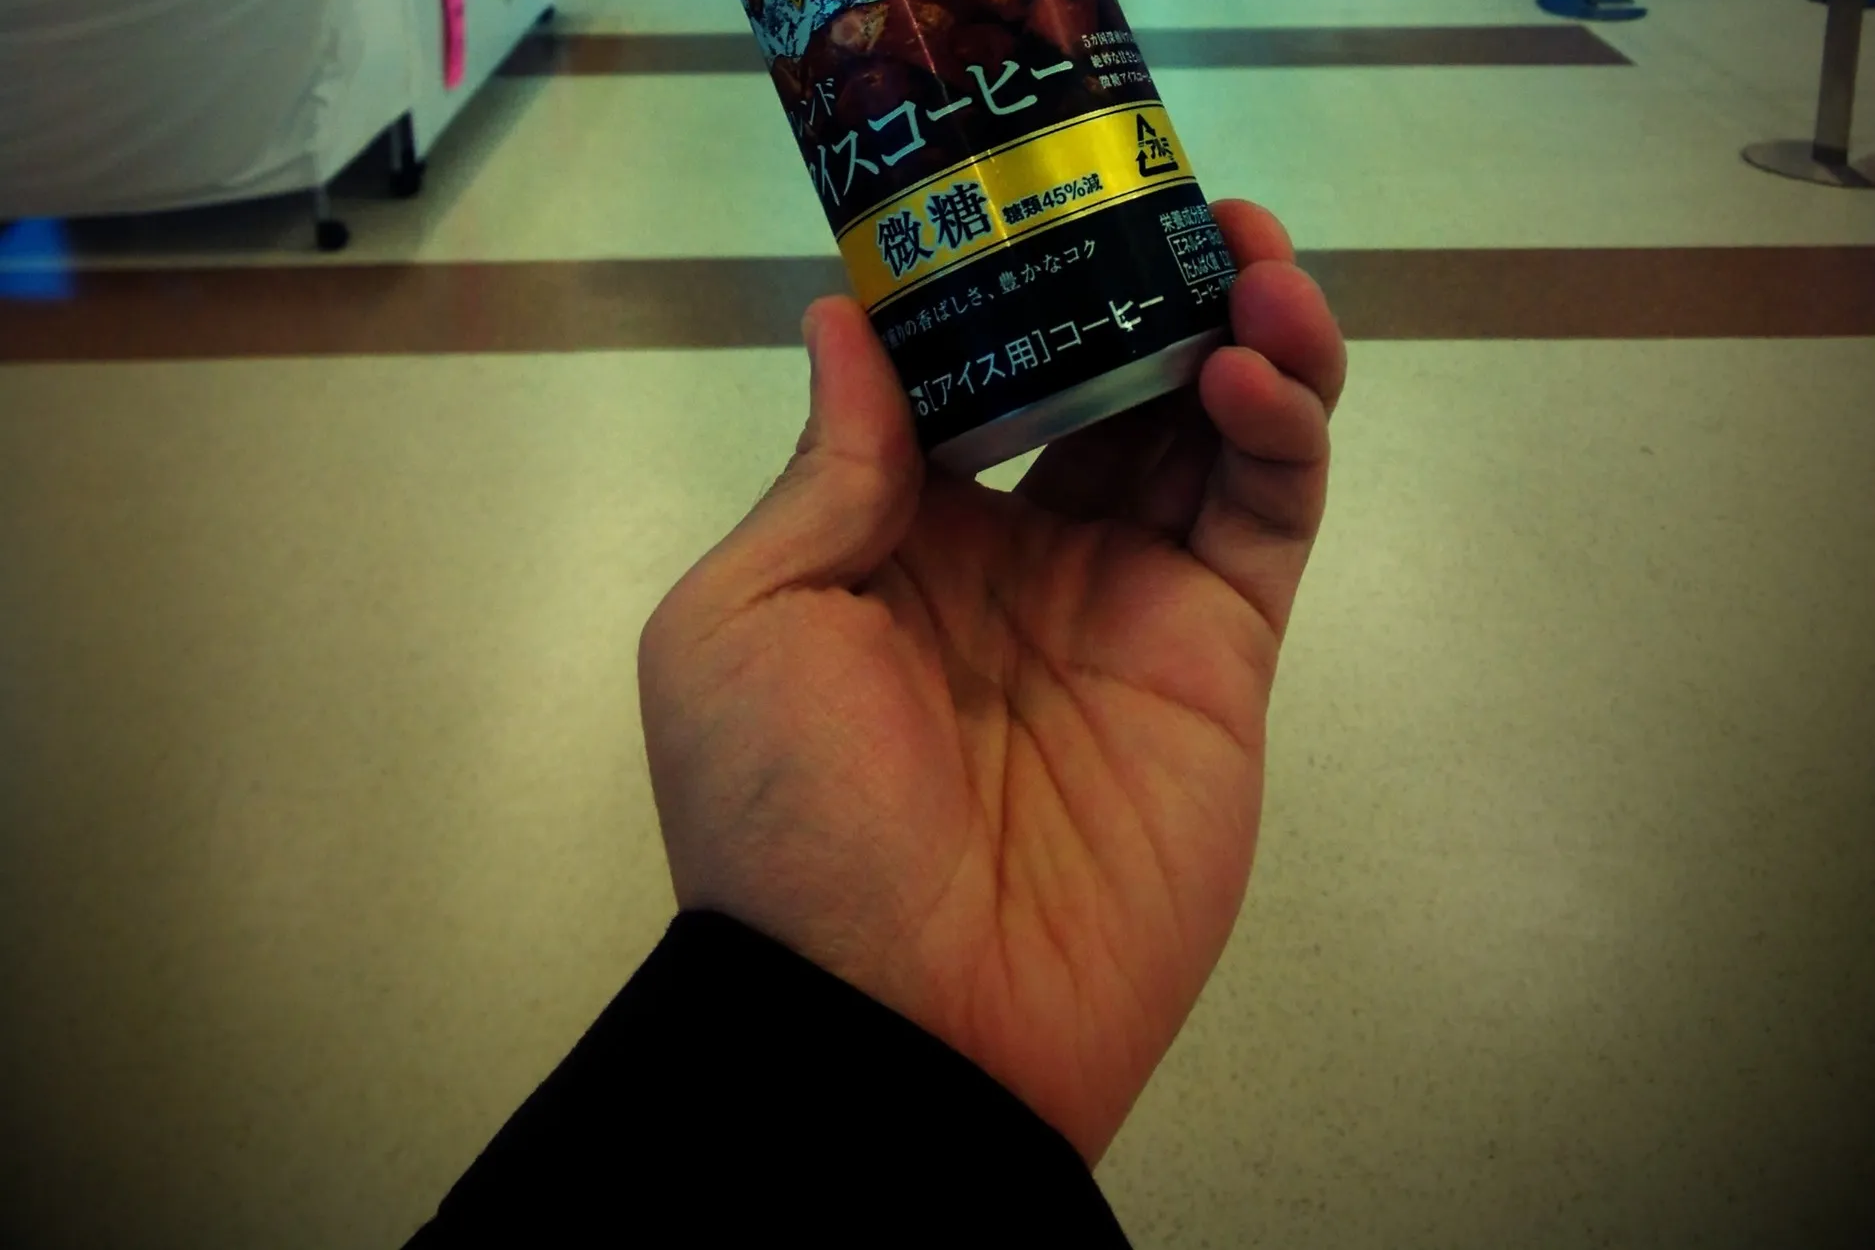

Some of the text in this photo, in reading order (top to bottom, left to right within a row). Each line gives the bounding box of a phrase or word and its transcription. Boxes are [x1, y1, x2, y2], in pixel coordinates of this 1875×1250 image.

[876, 181, 993, 278] 微糖
[1001, 172, 1104, 226] 糖類45%減
